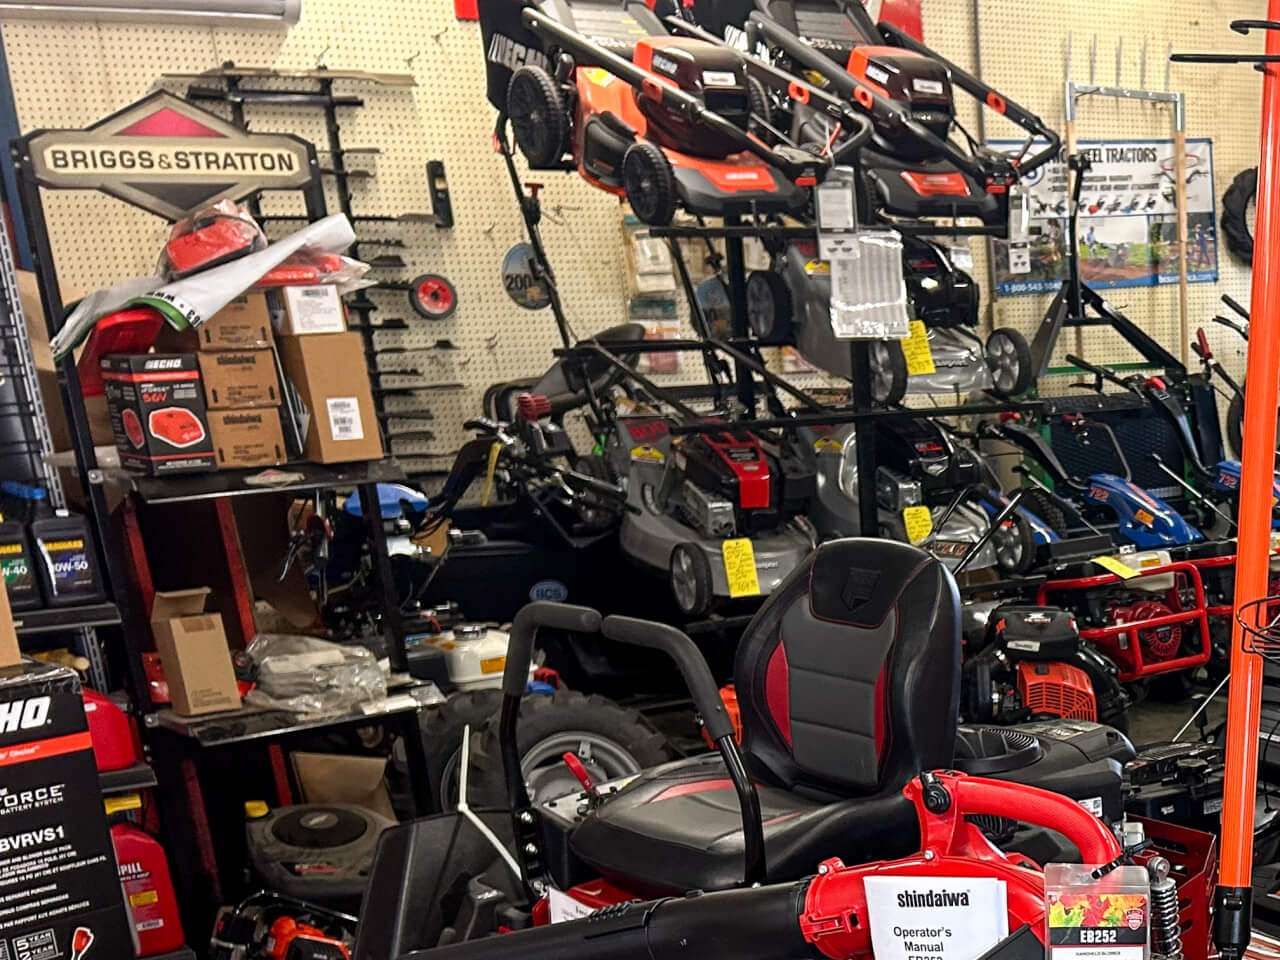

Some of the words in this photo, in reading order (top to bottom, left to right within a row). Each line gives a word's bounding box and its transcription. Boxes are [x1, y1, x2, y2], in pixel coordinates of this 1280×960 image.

[51, 150, 156, 170] BRIGGS
[158, 153, 172, 169] &
[174, 151, 295, 172] STRATTON
[1106, 148, 1157, 163] TRACTORS
[0, 696, 51, 732] HO
[897, 889, 969, 908] shindaiwa
[893, 926, 952, 940] Operator's
[1080, 930, 1118, 944] EB252
[904, 941, 944, 952] Manual
